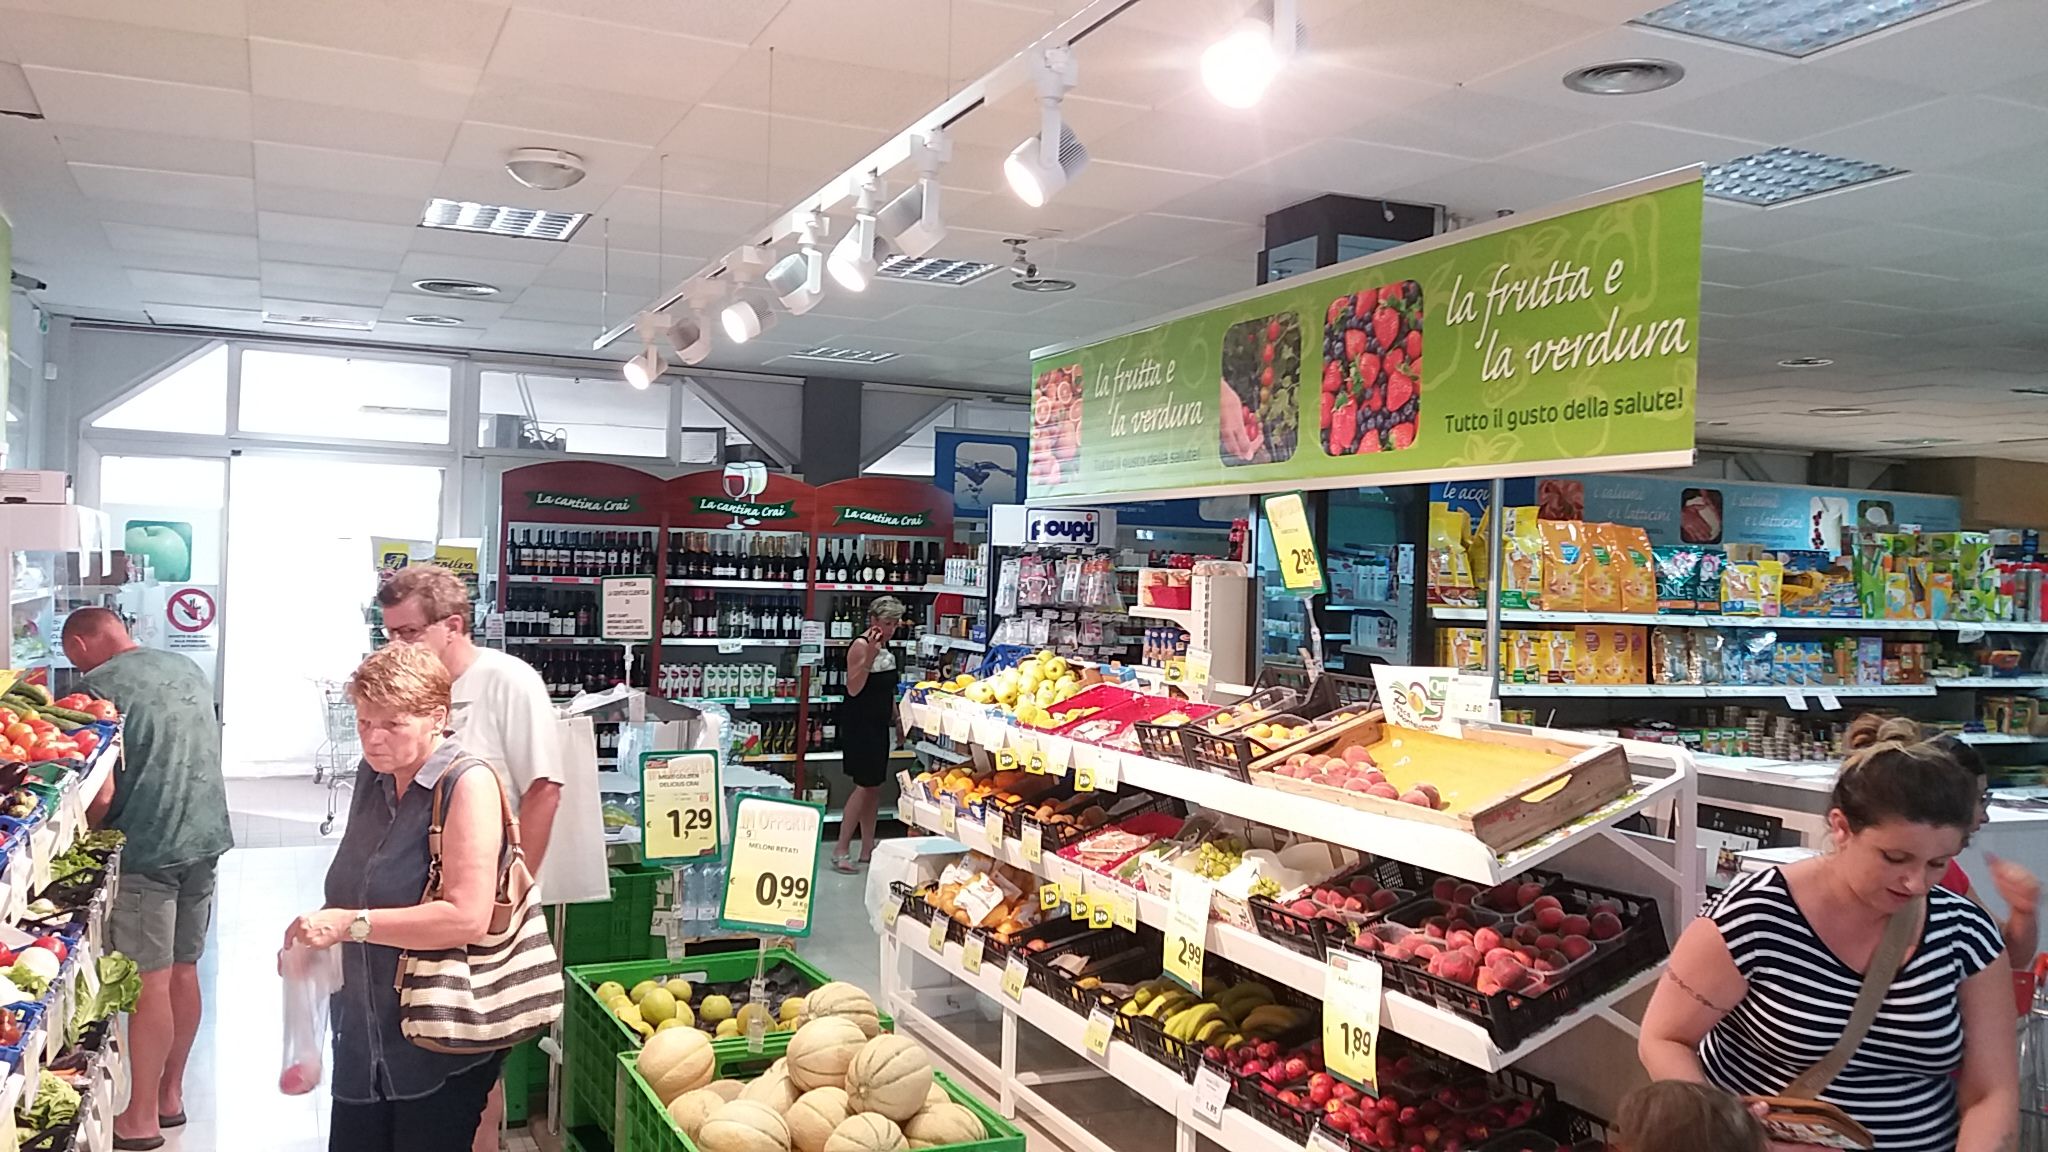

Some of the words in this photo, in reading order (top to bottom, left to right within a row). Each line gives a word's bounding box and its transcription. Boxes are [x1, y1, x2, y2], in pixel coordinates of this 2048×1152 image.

[1446, 274, 1478, 326] la
[1474, 260, 1594, 349] frutta
[1604, 258, 1624, 295] e
[1481, 329, 1515, 382] la
[1525, 306, 1691, 374] verdura
[1094, 363, 1110, 398] la
[1108, 358, 1162, 415] frutta
[1166, 359, 1176, 383] e
[1111, 402, 1125, 437] la
[1131, 391, 1204, 434] verdura
[1445, 413, 1489, 433] Tutto
[1493, 408, 1503, 428] il
[1507, 405, 1558, 432] gusto
[1563, 397, 1609, 422] della
[1614, 387, 1684, 415] salute!
[536, 493, 554, 504] La
[554, 495, 602, 511] cantina
[603, 499, 630, 511] Crai
[1442, 481, 1457, 498] le
[1457, 487, 1491, 512] acqu
[700, 499, 717, 509] La
[717, 502, 761, 516] cantina
[761, 505, 787, 517] Crai
[844, 508, 860, 519] La
[860, 511, 900, 525] cantina
[901, 514, 924, 526] Crai
[1624, 504, 1672, 522] latticini
[1758, 510, 1804, 529] latticini
[1291, 548, 1315, 574] 2,80
[1000, 755, 1012, 765] Bio
[1030, 757, 1042, 768] Bio
[666, 808, 712, 840] 1,29
[748, 842, 775, 852] MELONI
[755, 871, 809, 909] 0,99
[1045, 893, 1056, 904] Bio
[1076, 902, 1087, 914] Bio
[1094, 911, 1108, 923] Bio
[1178, 936, 1201, 969] 2,99
[1340, 1022, 1371, 1061] 1,89
